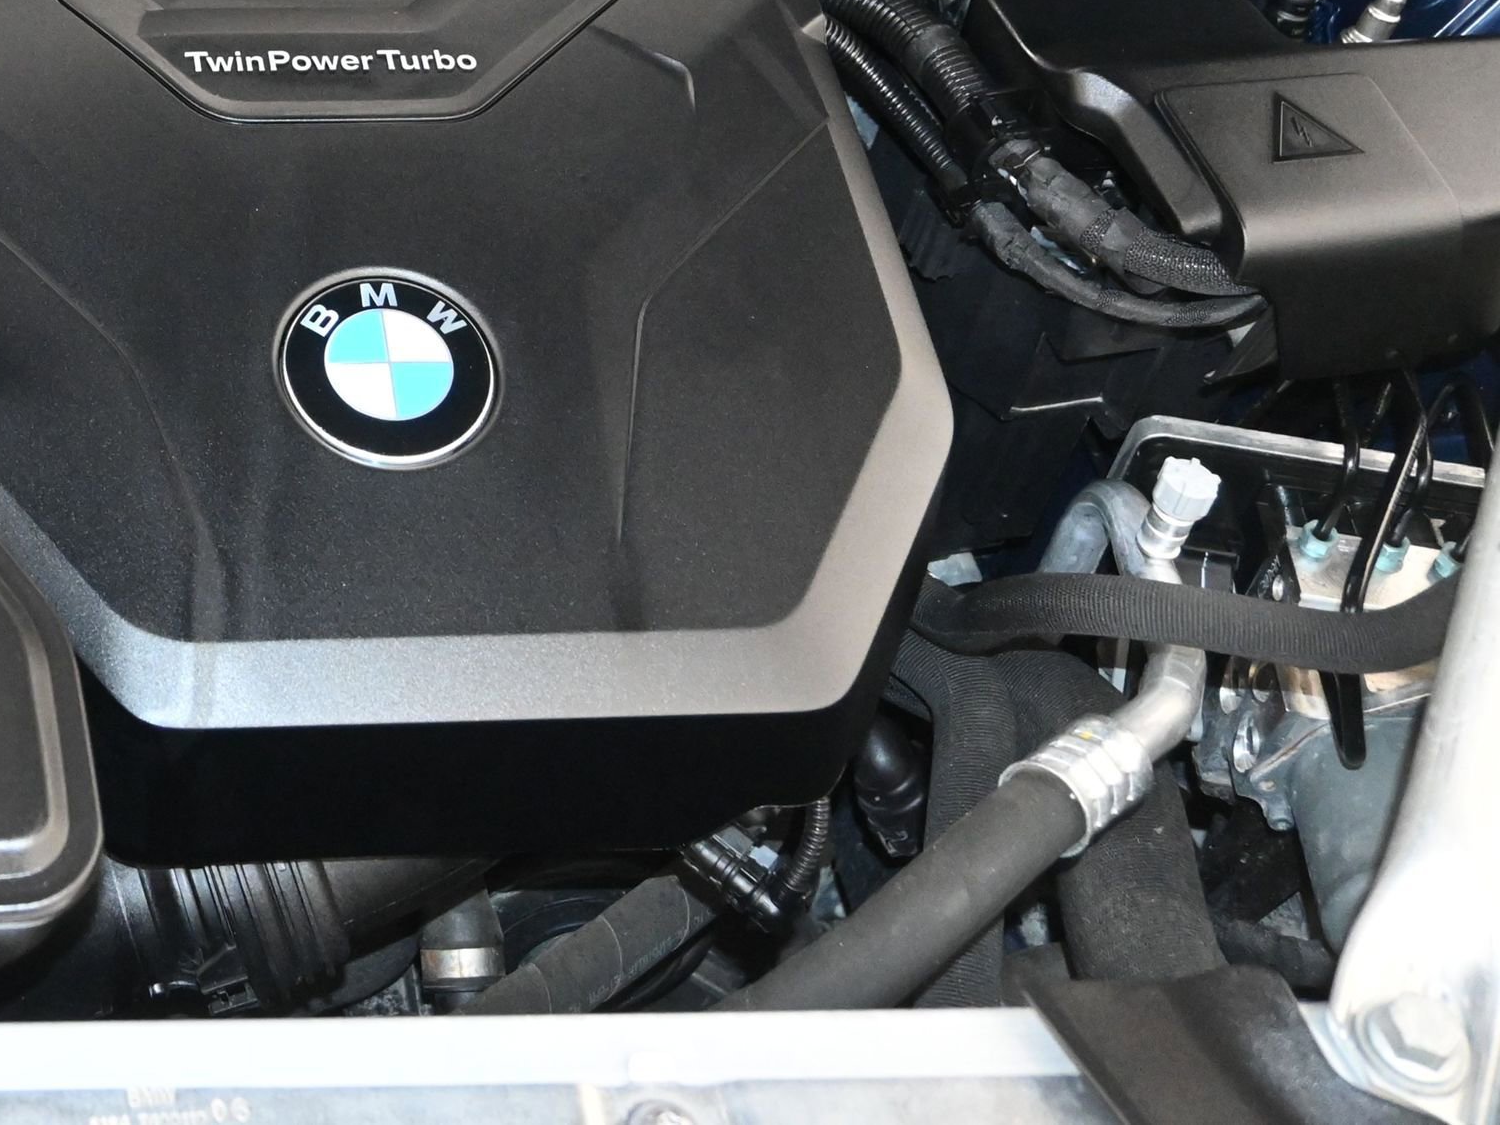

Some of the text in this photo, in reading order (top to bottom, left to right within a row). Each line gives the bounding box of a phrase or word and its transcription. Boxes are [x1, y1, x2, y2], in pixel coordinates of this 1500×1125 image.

[184, 48, 478, 73] TwinPower Turbo
[300, 282, 468, 338] BMW
